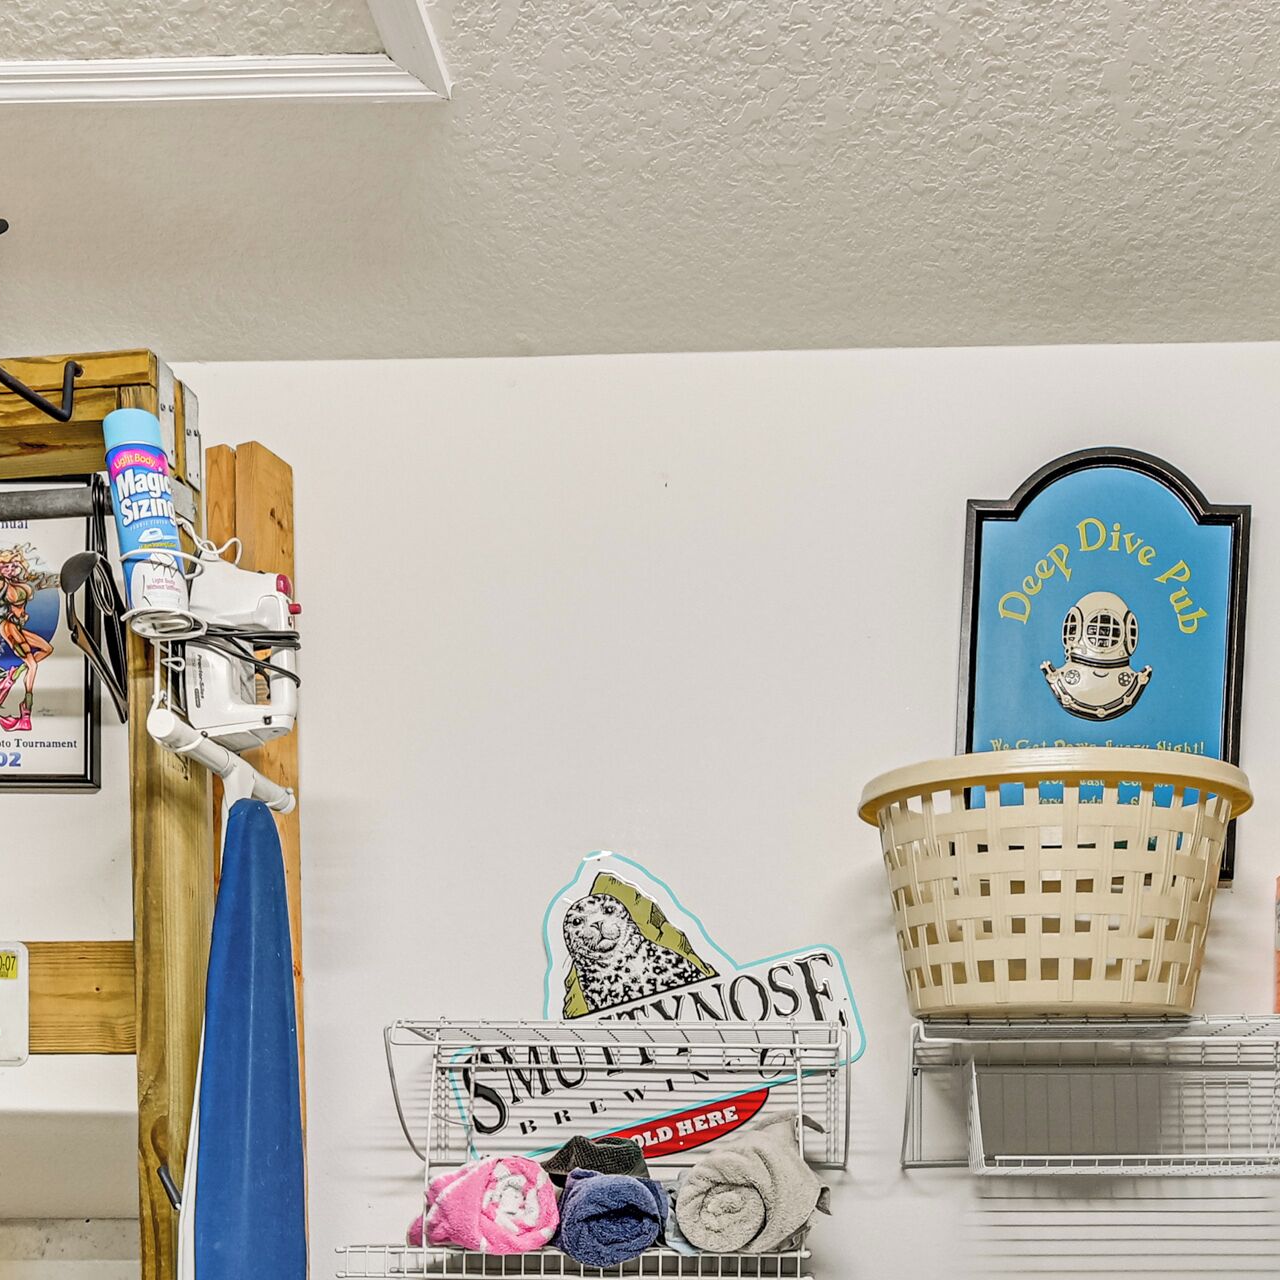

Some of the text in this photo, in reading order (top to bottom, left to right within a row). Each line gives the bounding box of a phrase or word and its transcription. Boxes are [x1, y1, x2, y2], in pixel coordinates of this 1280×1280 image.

[134, 453, 156, 467] Body
[116, 467, 172, 502] Magic
[121, 498, 176, 527] Sizing
[998, 517, 1211, 635] Deep Dive Pub
[14, 738, 78, 748] Tournament
[631, 1105, 738, 1150] OLD HERE
